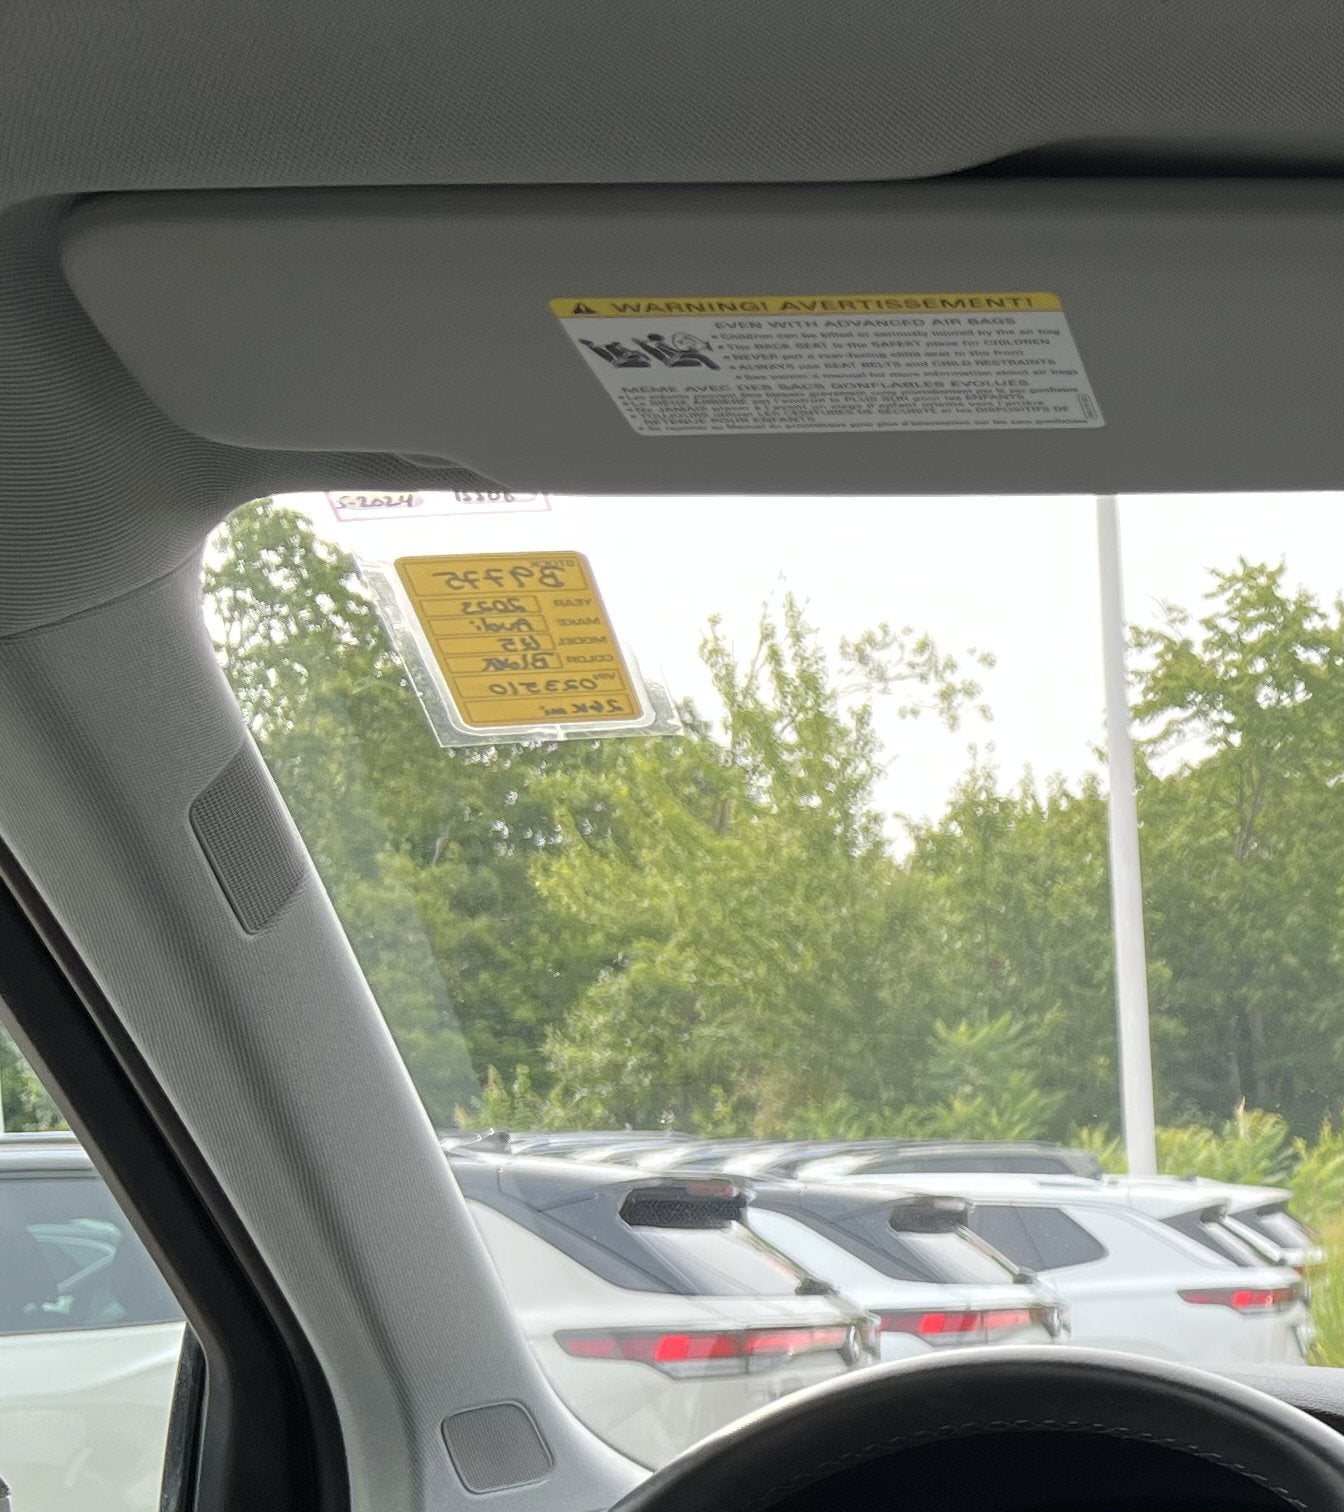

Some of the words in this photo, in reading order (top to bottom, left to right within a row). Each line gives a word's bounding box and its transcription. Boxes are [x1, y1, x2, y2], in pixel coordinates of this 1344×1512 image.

[610, 302, 769, 313] WARNING!
[782, 297, 1034, 312] AVERTISSEMENT!
[715, 321, 763, 329] EVEN
[768, 320, 818, 328] WITH
[823, 318, 925, 328] ADVANCED
[931, 318, 962, 326] AIR
[968, 317, 1016, 325] BAGS
